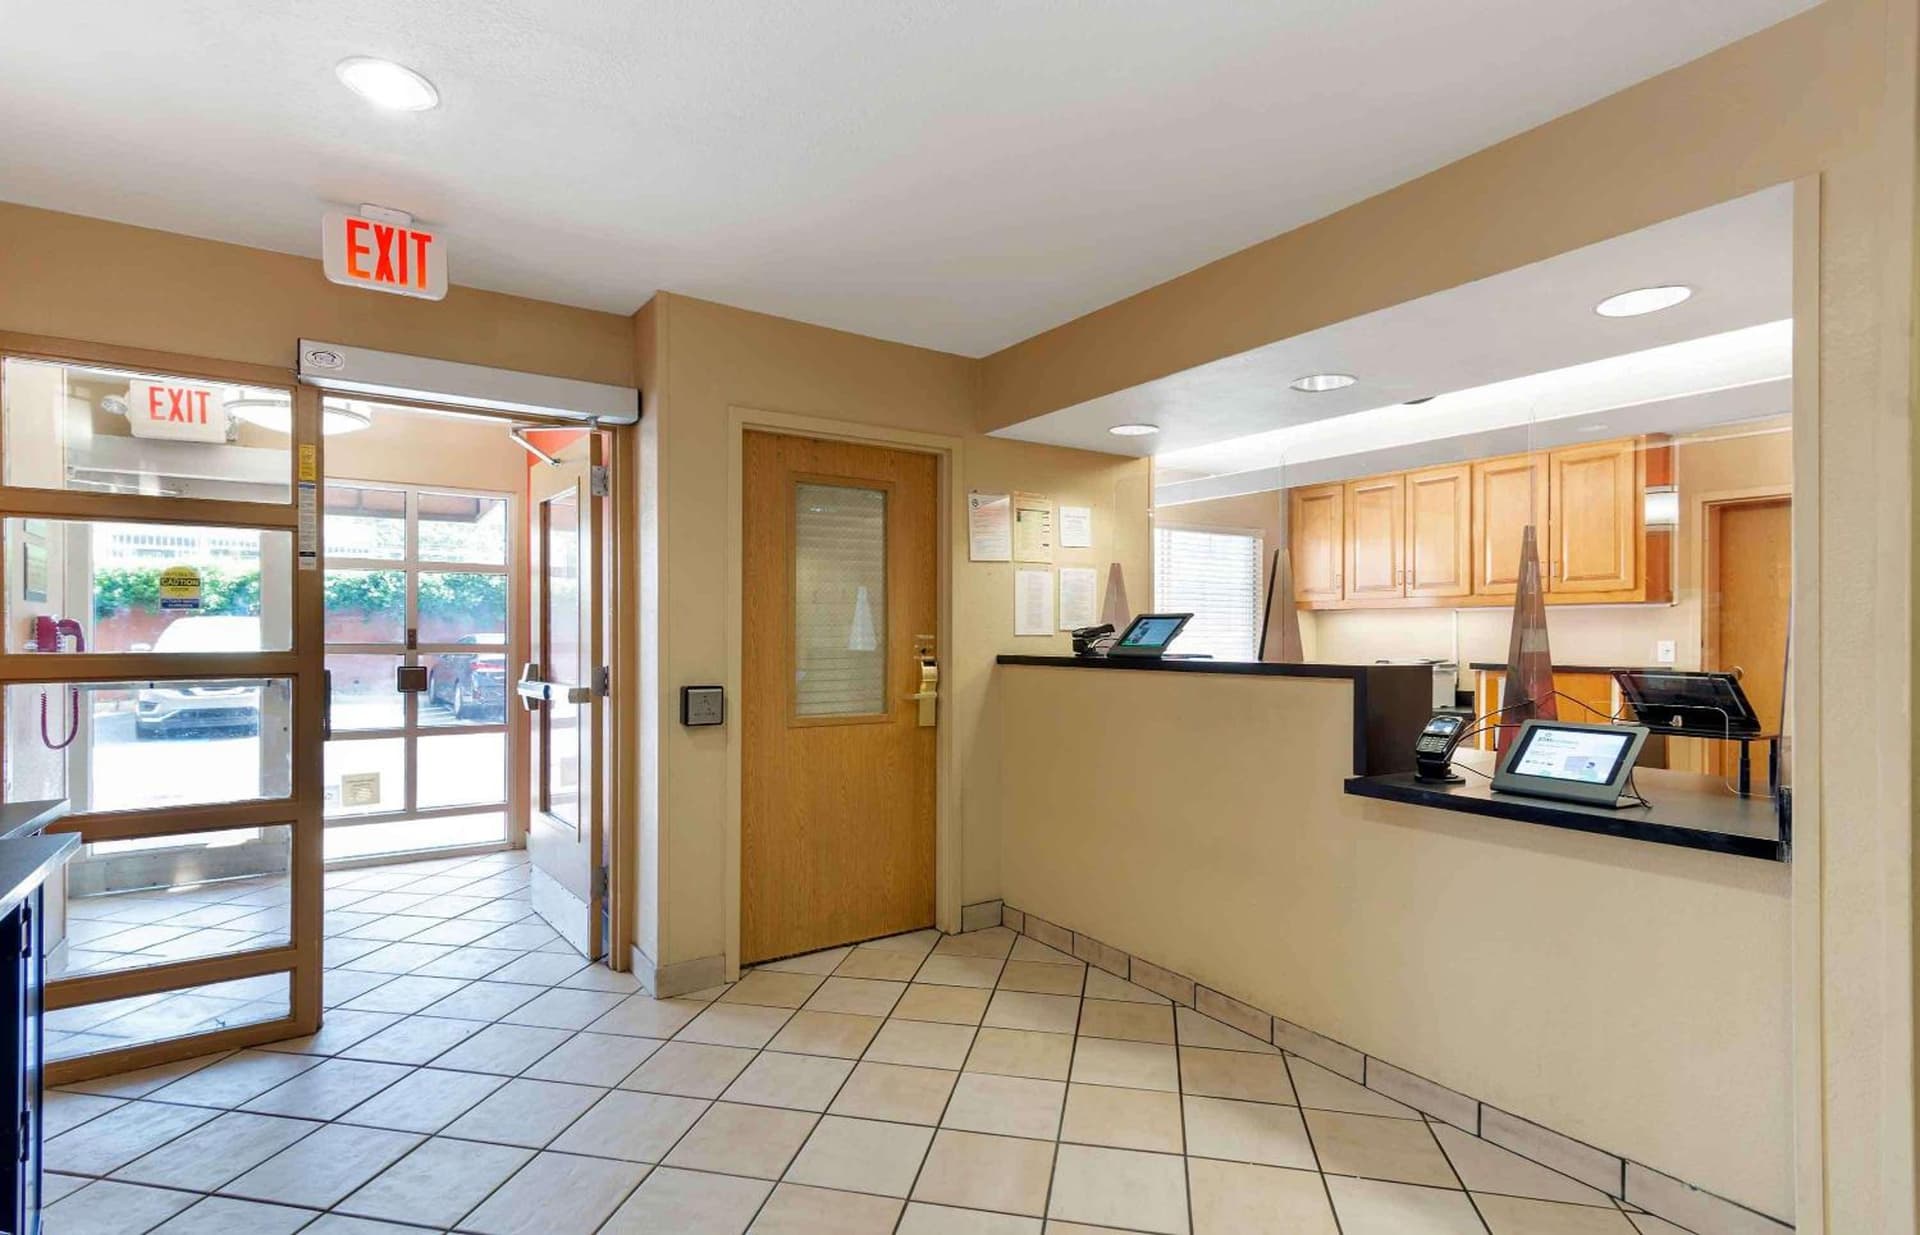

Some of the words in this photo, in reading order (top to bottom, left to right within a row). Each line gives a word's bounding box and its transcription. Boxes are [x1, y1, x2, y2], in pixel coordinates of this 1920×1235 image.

[346, 218, 432, 290] EXIT
[149, 386, 211, 425] EXIT
[161, 577, 199, 586] CAUTION
